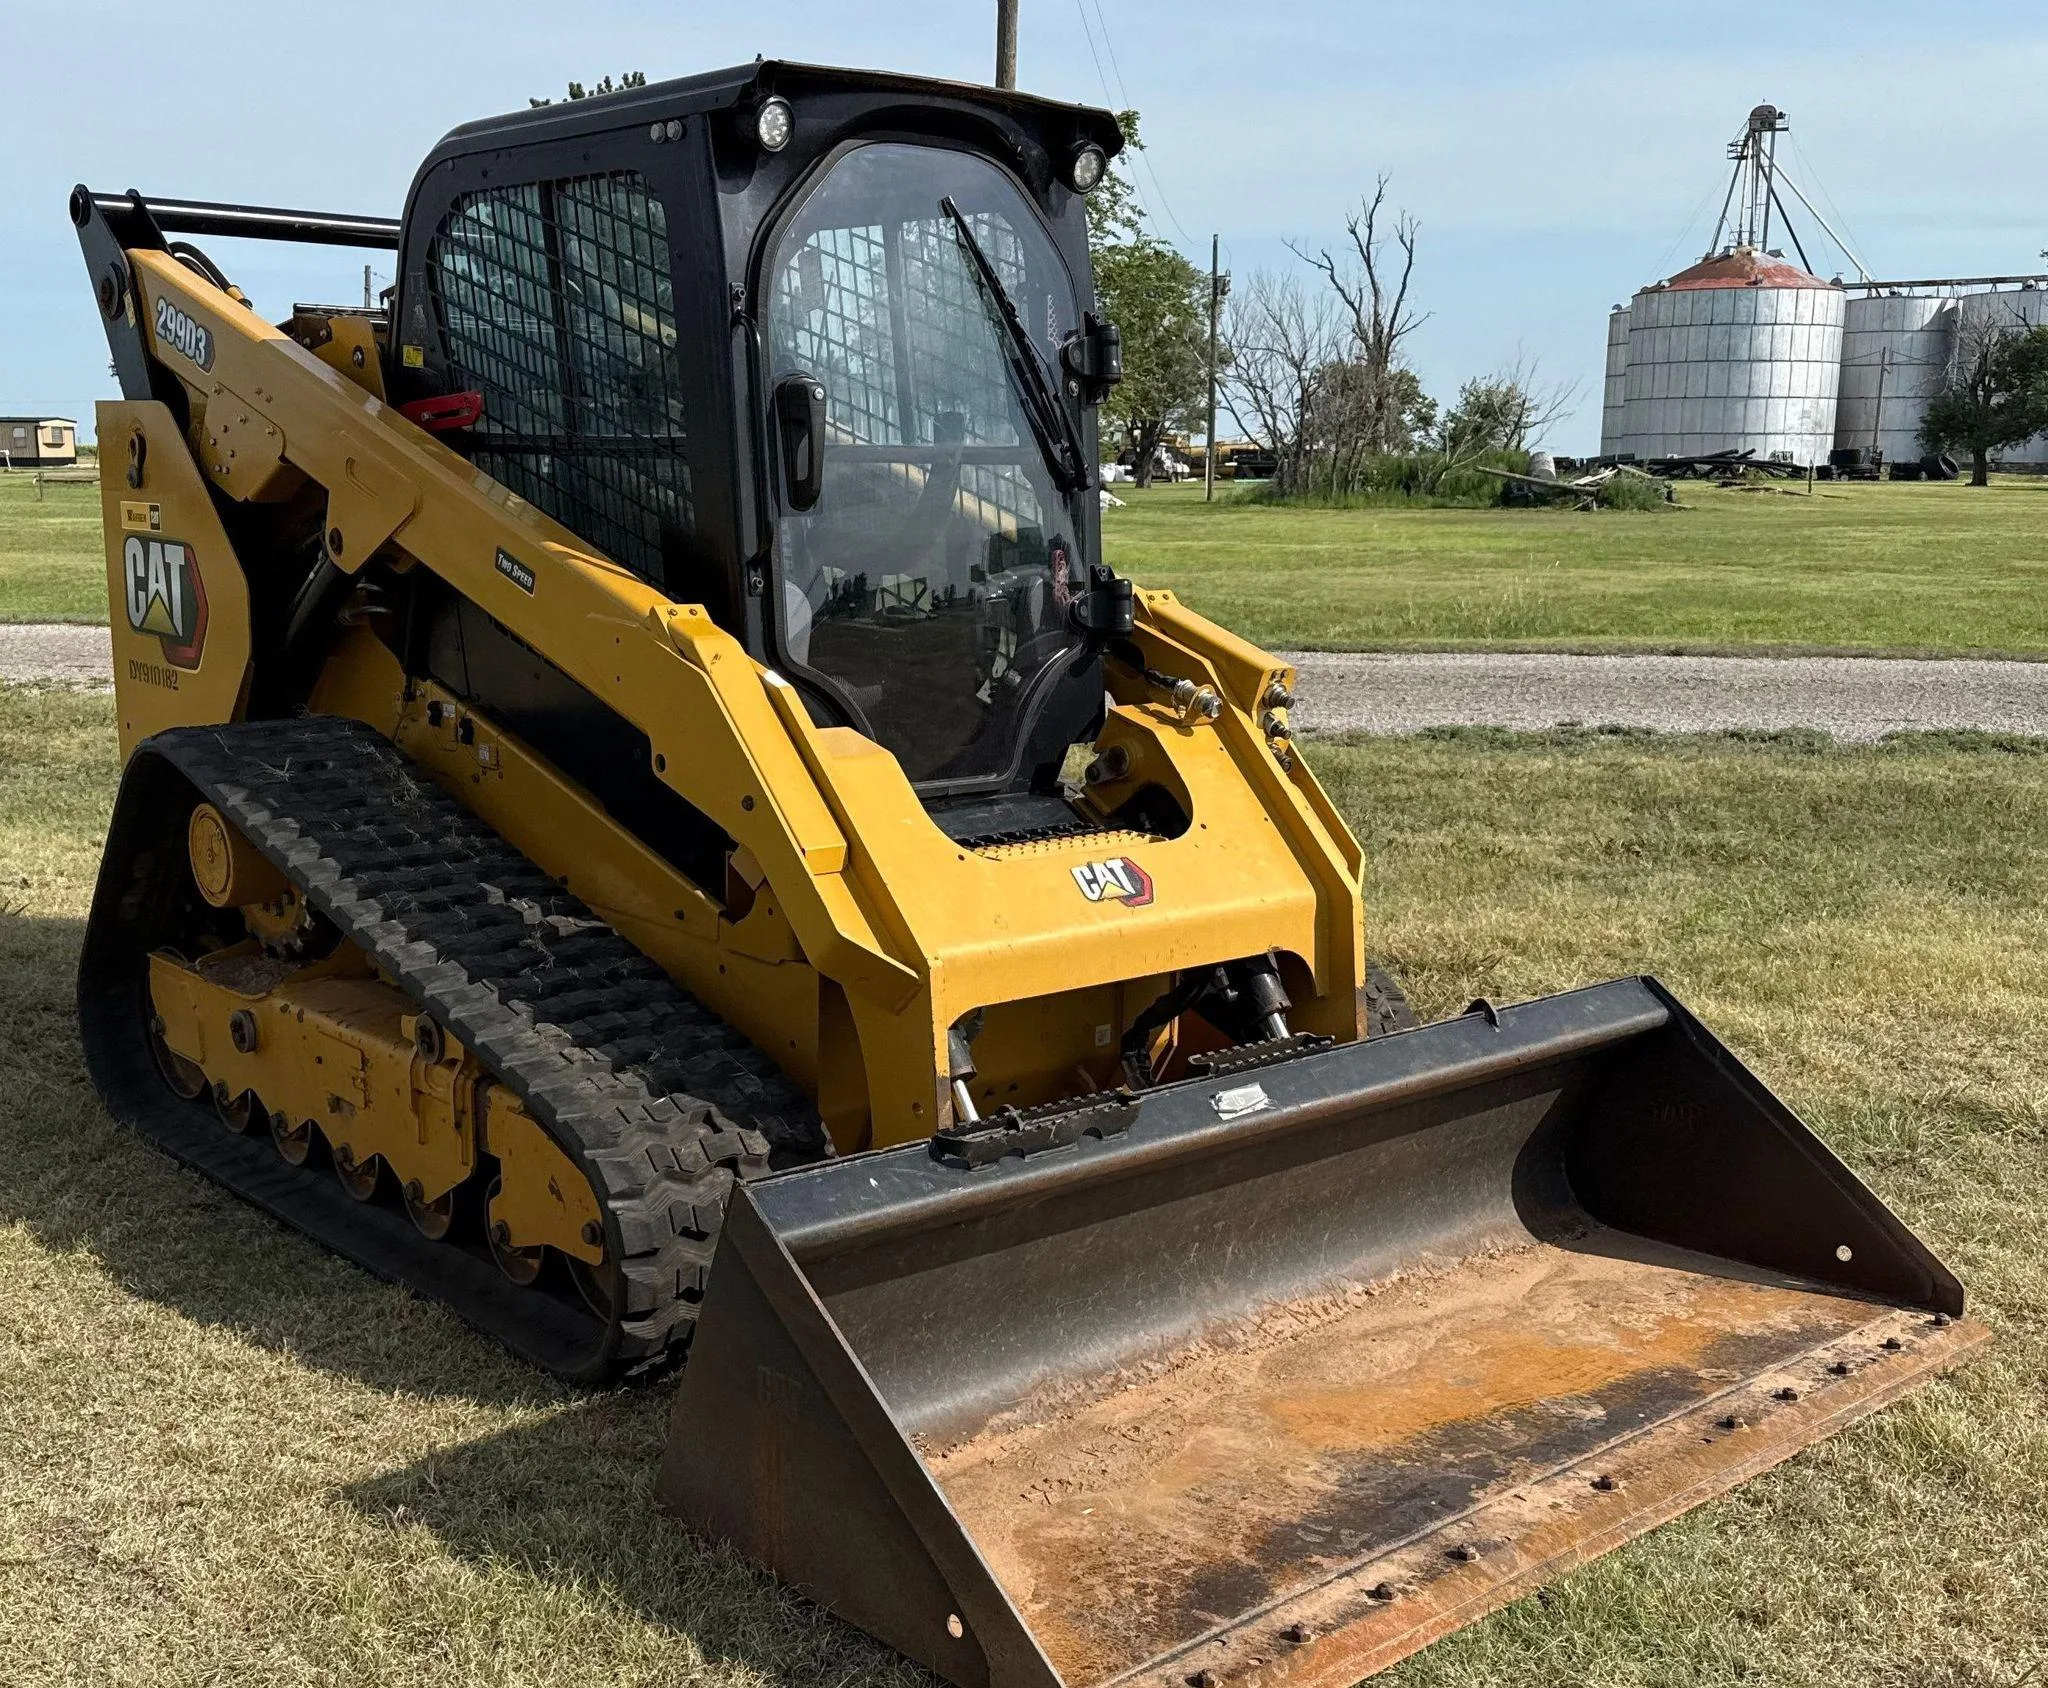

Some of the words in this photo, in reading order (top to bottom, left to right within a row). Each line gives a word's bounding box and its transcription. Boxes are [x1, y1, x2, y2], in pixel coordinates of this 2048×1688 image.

[156, 298, 206, 366] 299D3
[125, 537, 185, 637] CAT
[512, 564, 533, 587] SPEED
[1070, 858, 1136, 901] CAT
